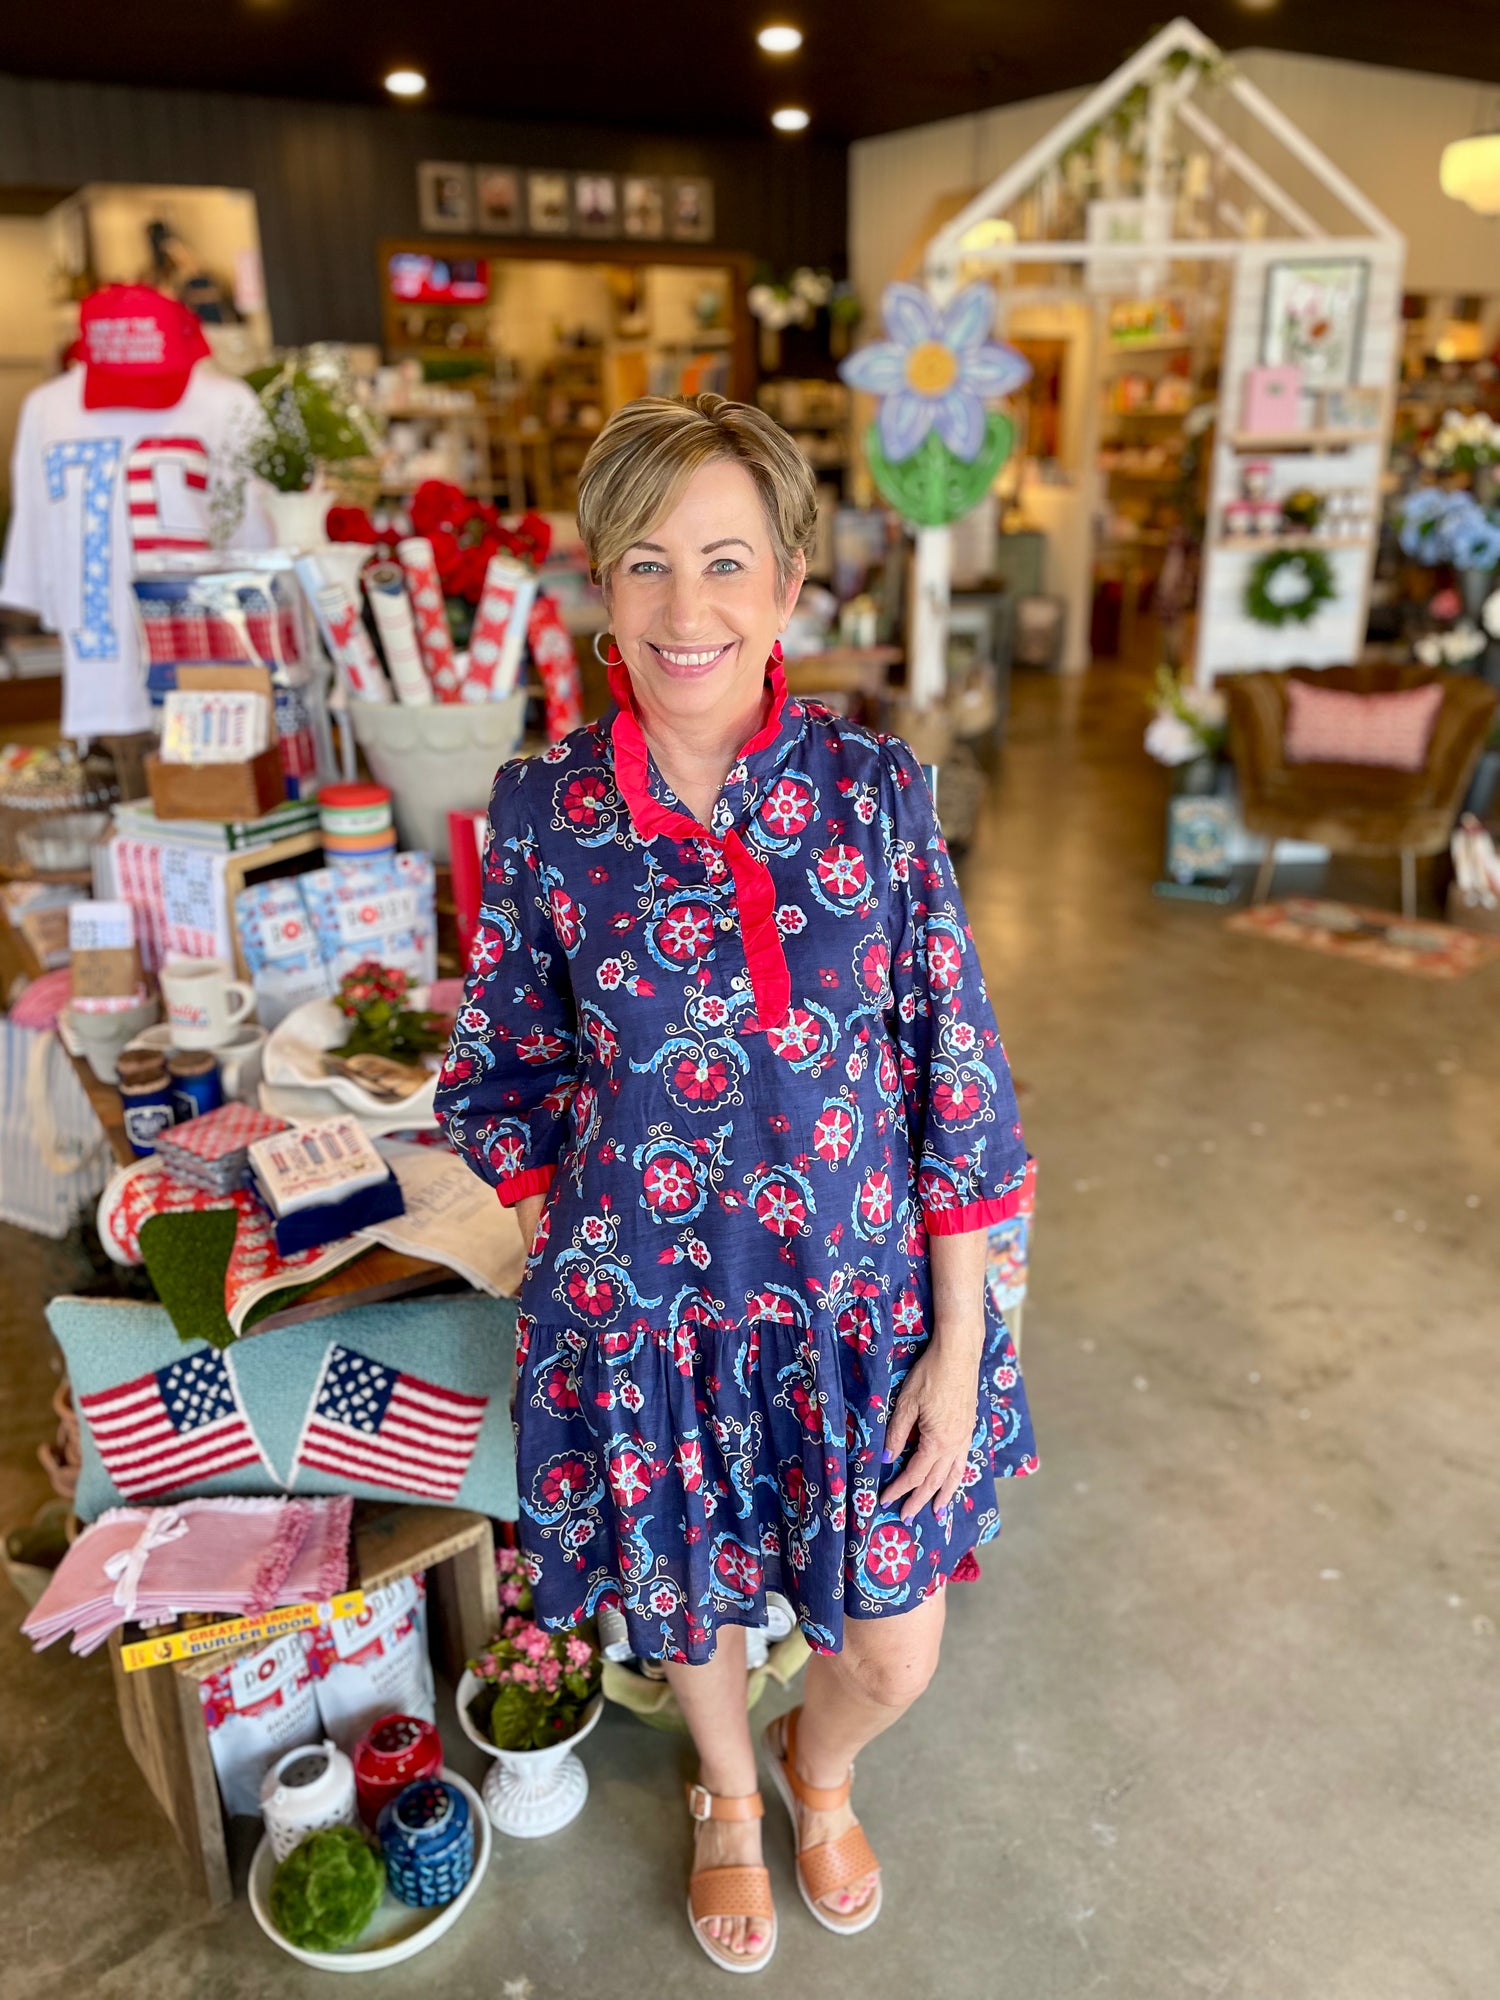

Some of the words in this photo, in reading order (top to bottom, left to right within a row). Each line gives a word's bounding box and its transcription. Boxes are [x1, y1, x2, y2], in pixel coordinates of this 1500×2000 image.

[188, 1622, 236, 1643] GREAT
[238, 1605, 313, 1628] AMERICAN
[190, 1629, 262, 1654] BURGER
[265, 1616, 315, 1636] BOOK
